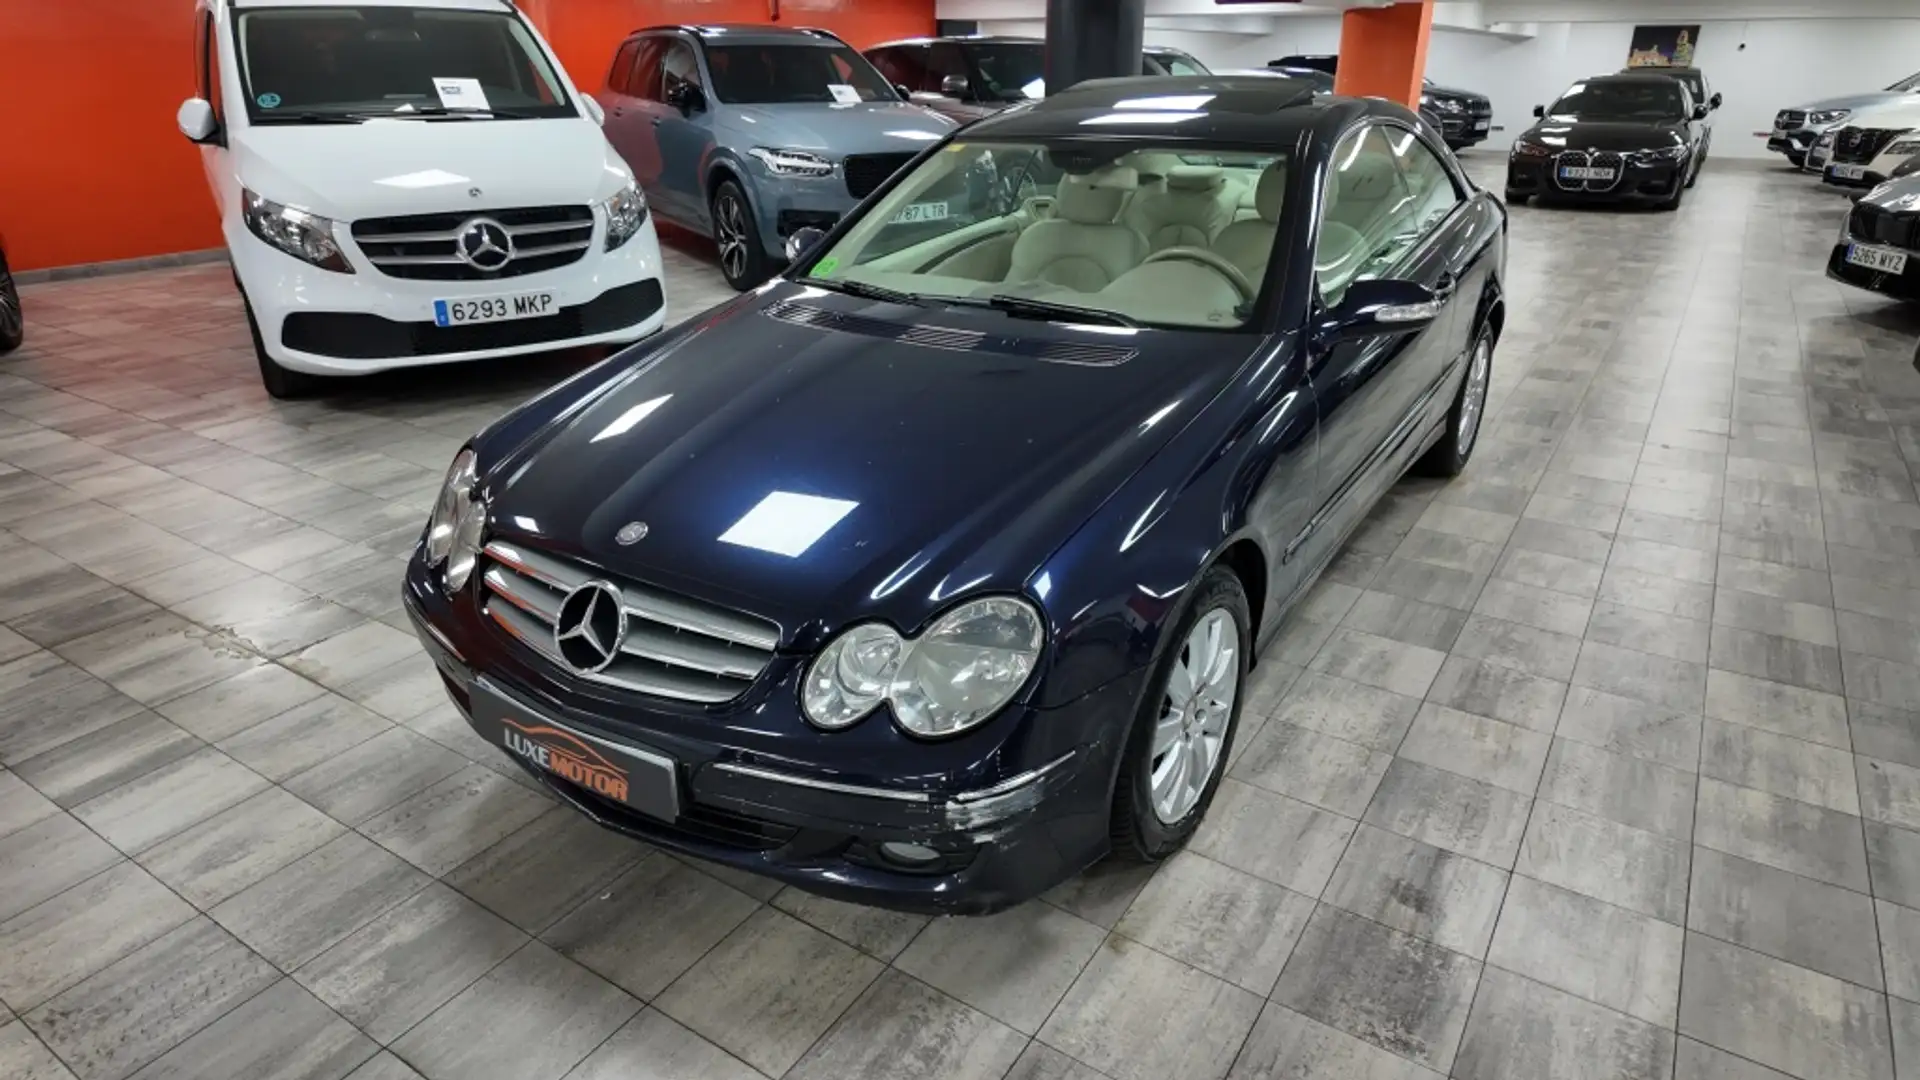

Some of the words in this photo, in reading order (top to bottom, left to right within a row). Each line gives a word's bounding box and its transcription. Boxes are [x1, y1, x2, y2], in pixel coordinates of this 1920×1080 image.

[452, 299, 508, 321] 6293
[513, 294, 553, 315] MKP
[504, 727, 629, 802] LUXEMOTOR
